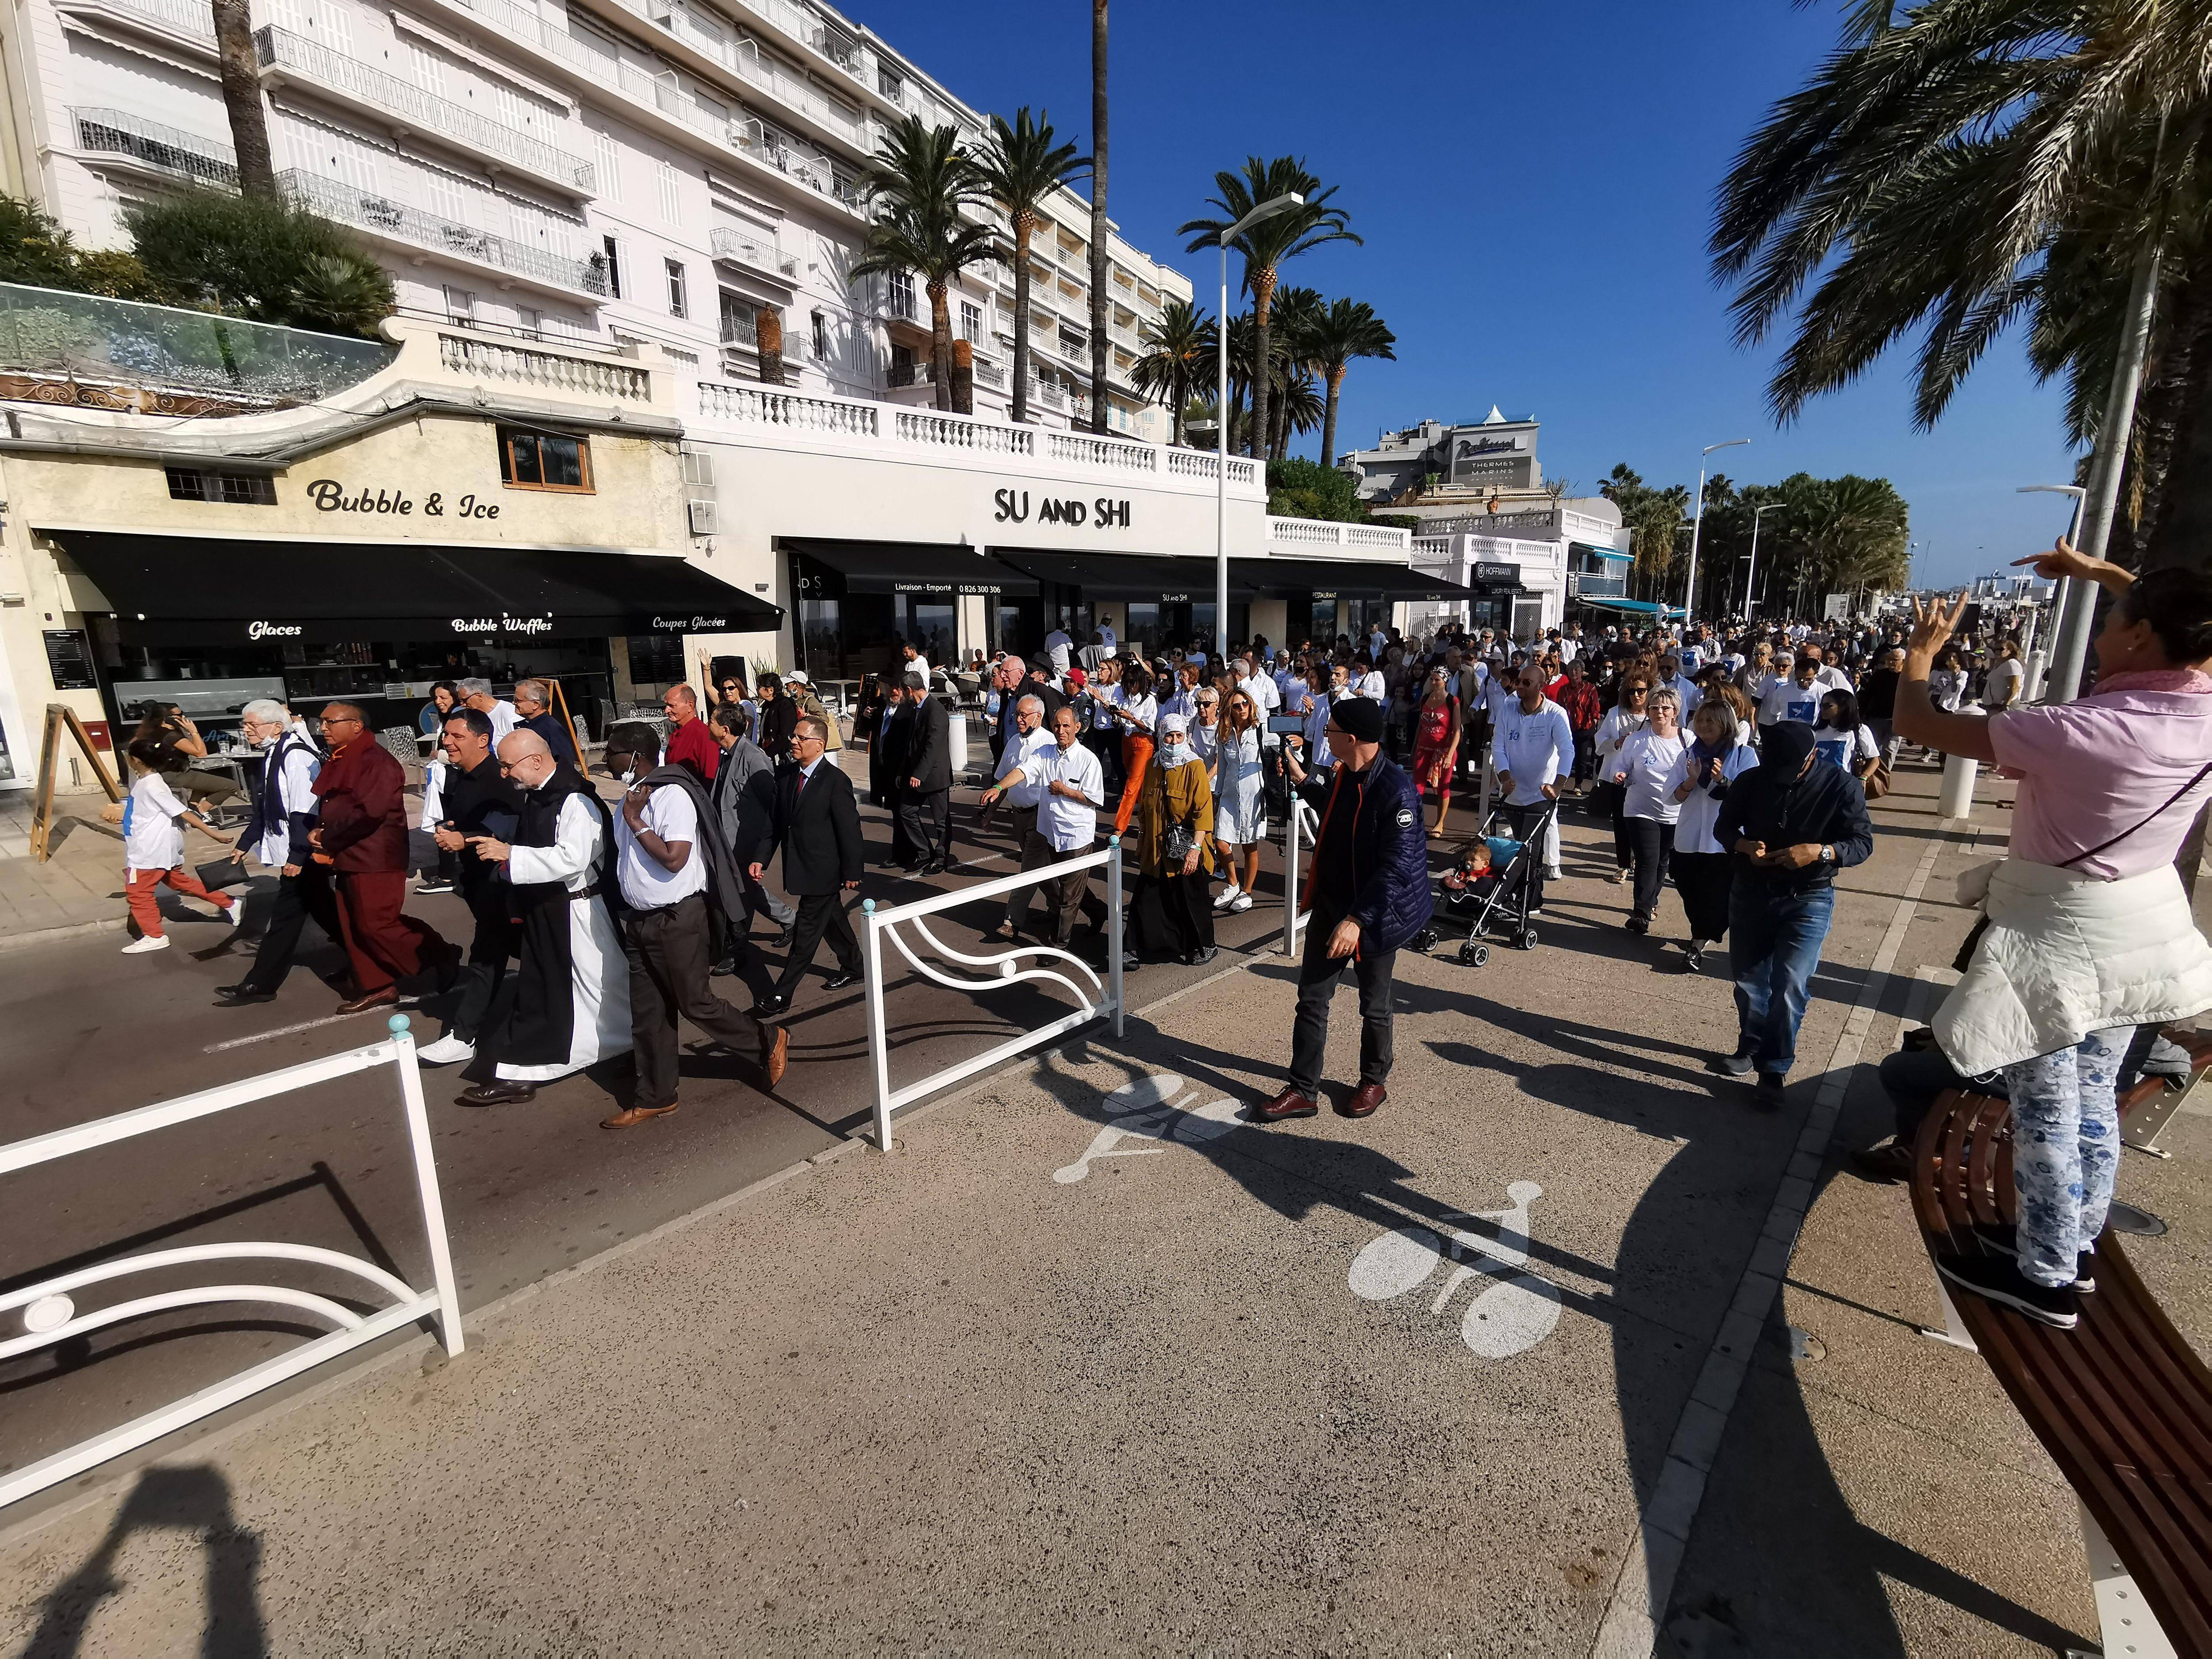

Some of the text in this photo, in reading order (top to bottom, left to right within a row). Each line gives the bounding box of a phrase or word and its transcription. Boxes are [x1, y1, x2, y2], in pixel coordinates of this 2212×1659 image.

[307, 479, 499, 519] Bubble & Ice
[995, 488, 1130, 530] SU AND SHI
[1486, 567, 1511, 576] HOFFMANN
[926, 584, 952, 592] Emporté
[249, 621, 302, 640] Glaces
[452, 618, 552, 635] Bubble Waffles
[653, 616, 726, 631] Coupes Glacées
